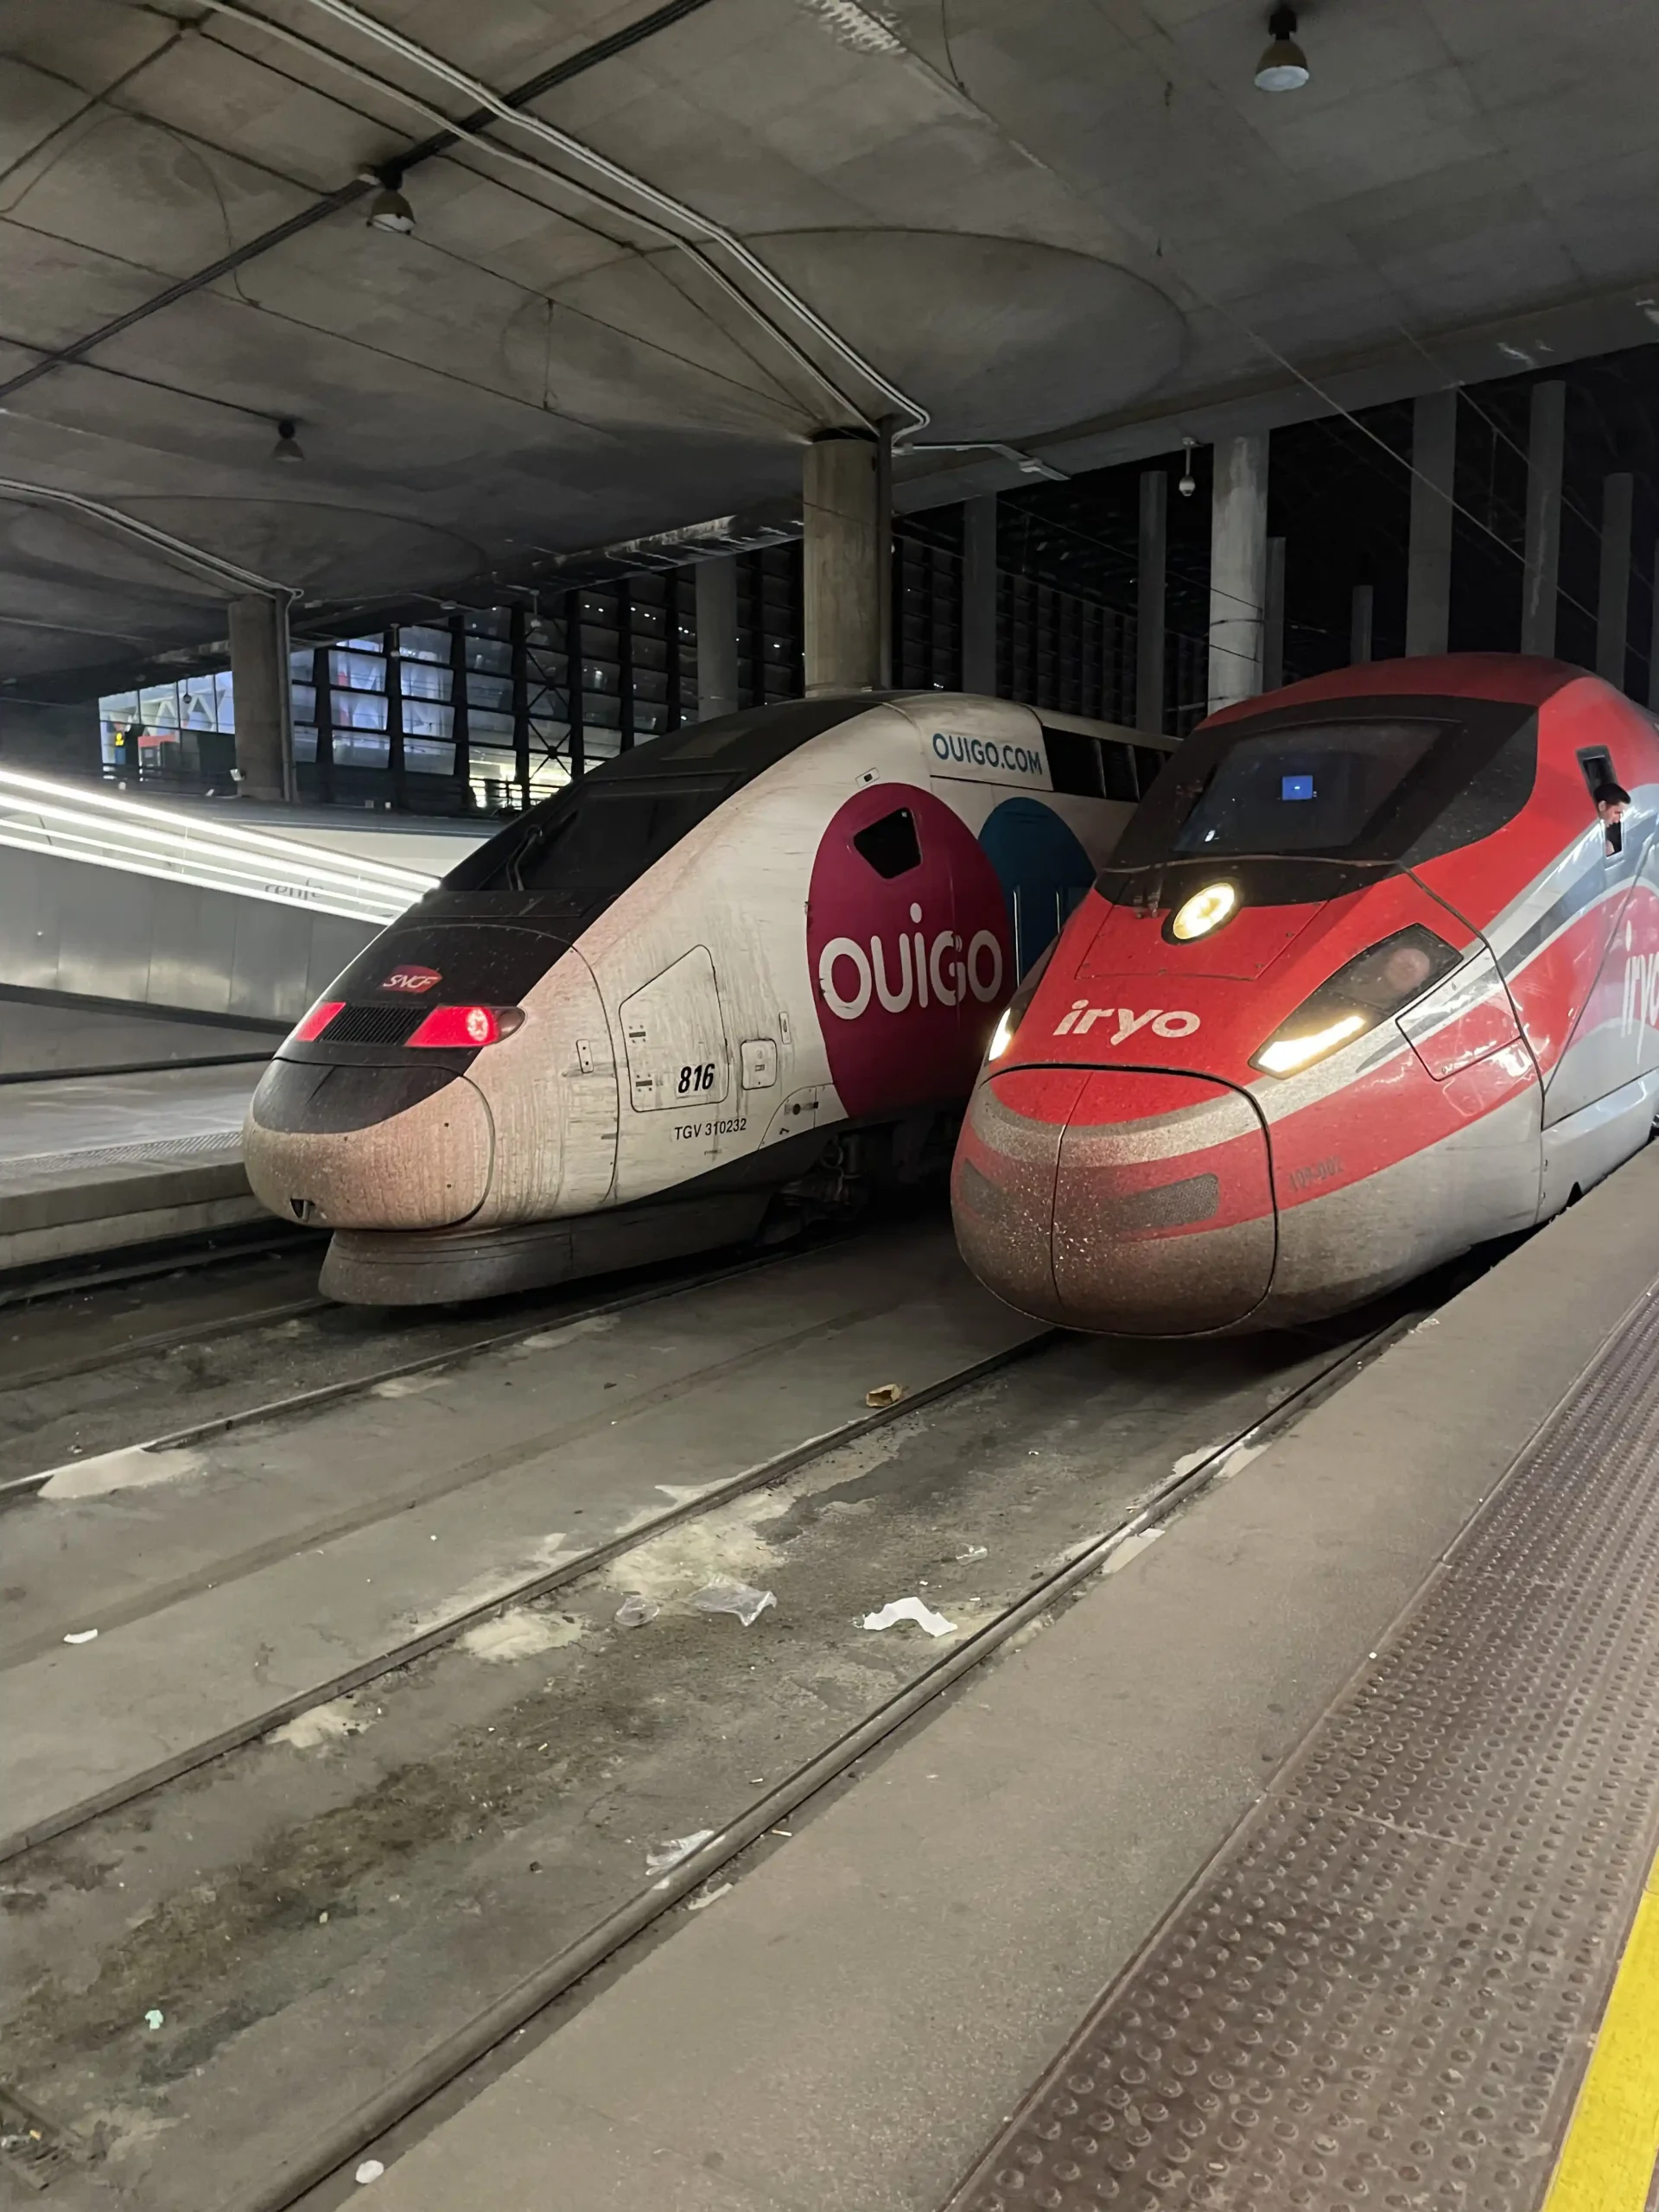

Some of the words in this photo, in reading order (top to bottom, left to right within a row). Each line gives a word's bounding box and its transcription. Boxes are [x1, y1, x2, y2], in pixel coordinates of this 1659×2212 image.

[932, 733, 1043, 775] OUIGO.COM
[383, 974, 438, 988] SNCF
[1052, 999, 1201, 1046] iryo
[677, 1063, 715, 1094] 816
[674, 1123, 702, 1141] TGV
[705, 1117, 747, 1136] 310232
